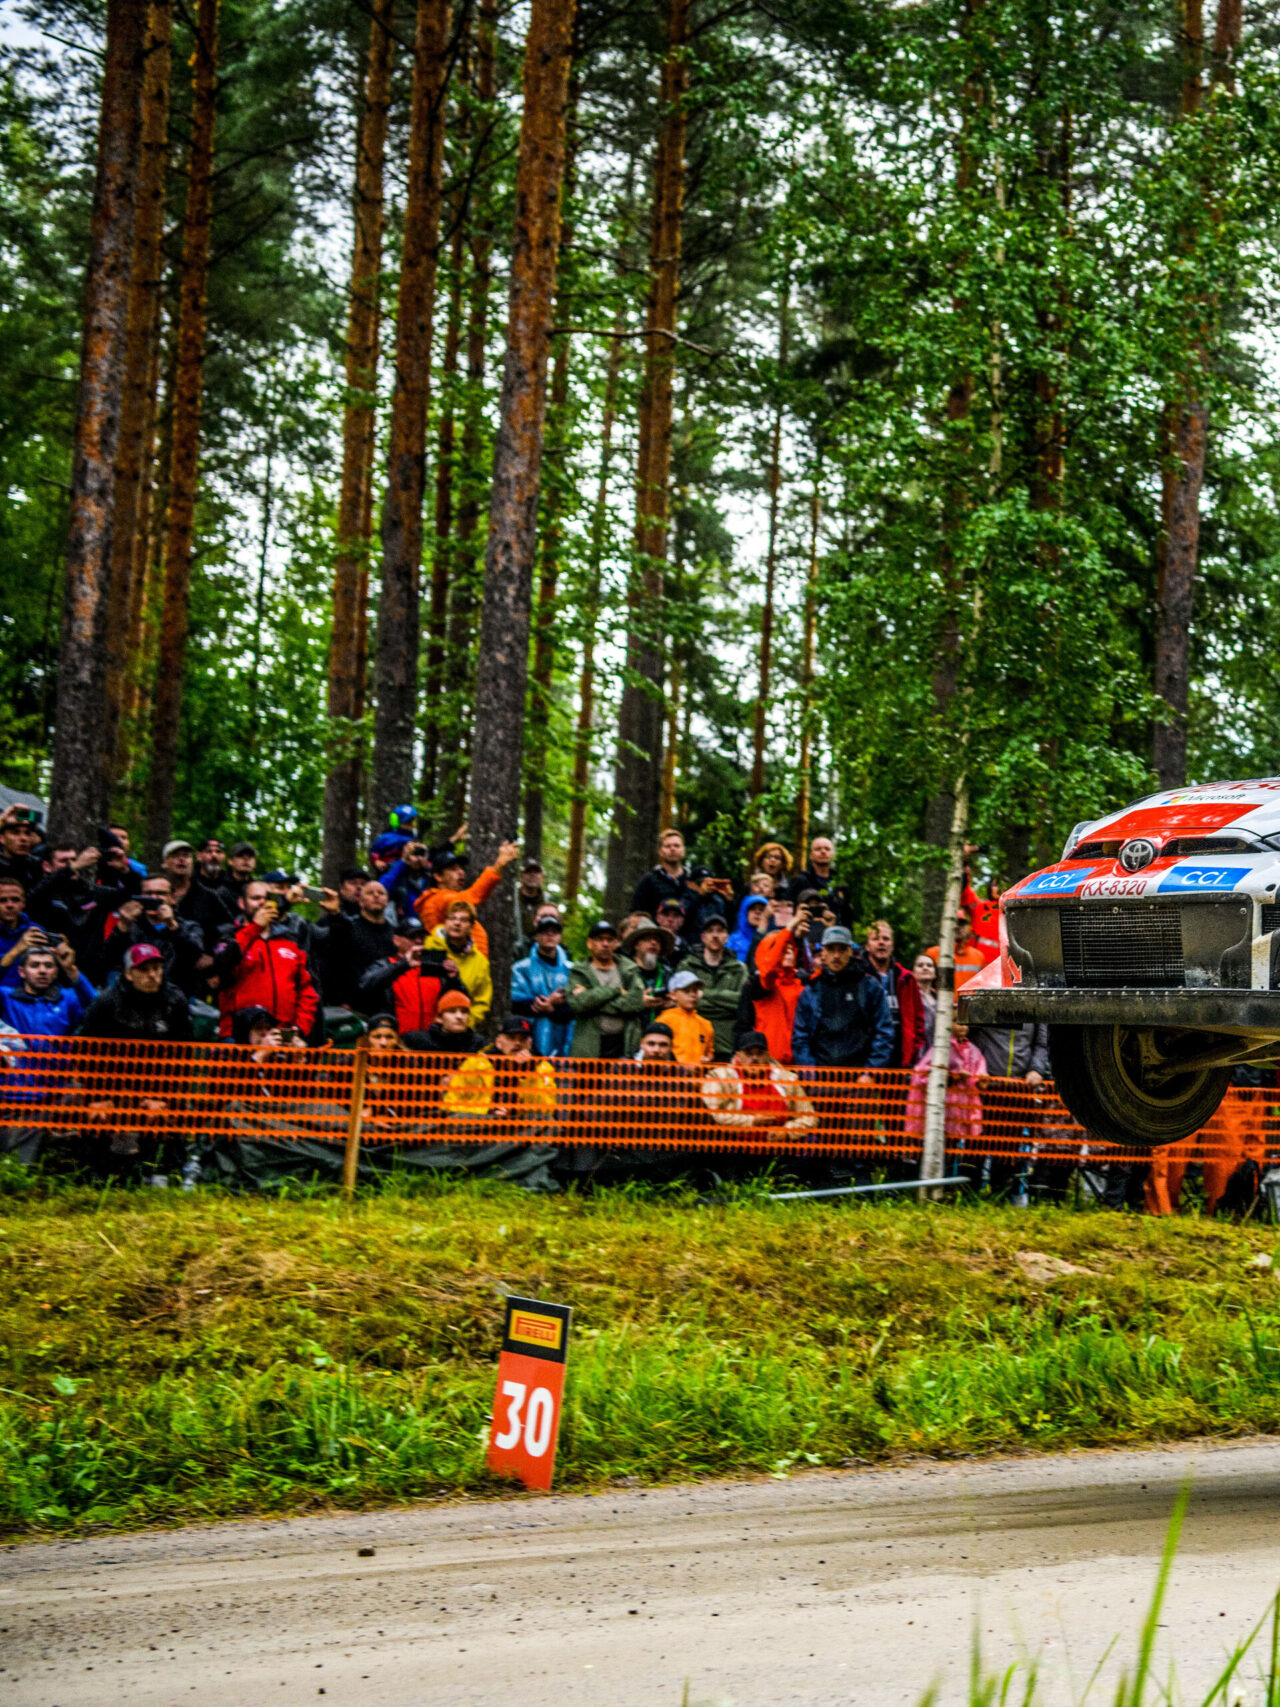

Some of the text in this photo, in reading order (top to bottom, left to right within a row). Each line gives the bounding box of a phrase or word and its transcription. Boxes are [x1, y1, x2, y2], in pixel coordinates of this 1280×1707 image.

[1082, 880, 1148, 897] KX-8320
[514, 1316, 557, 1343] PIRELLI
[494, 1380, 554, 1458] 30
